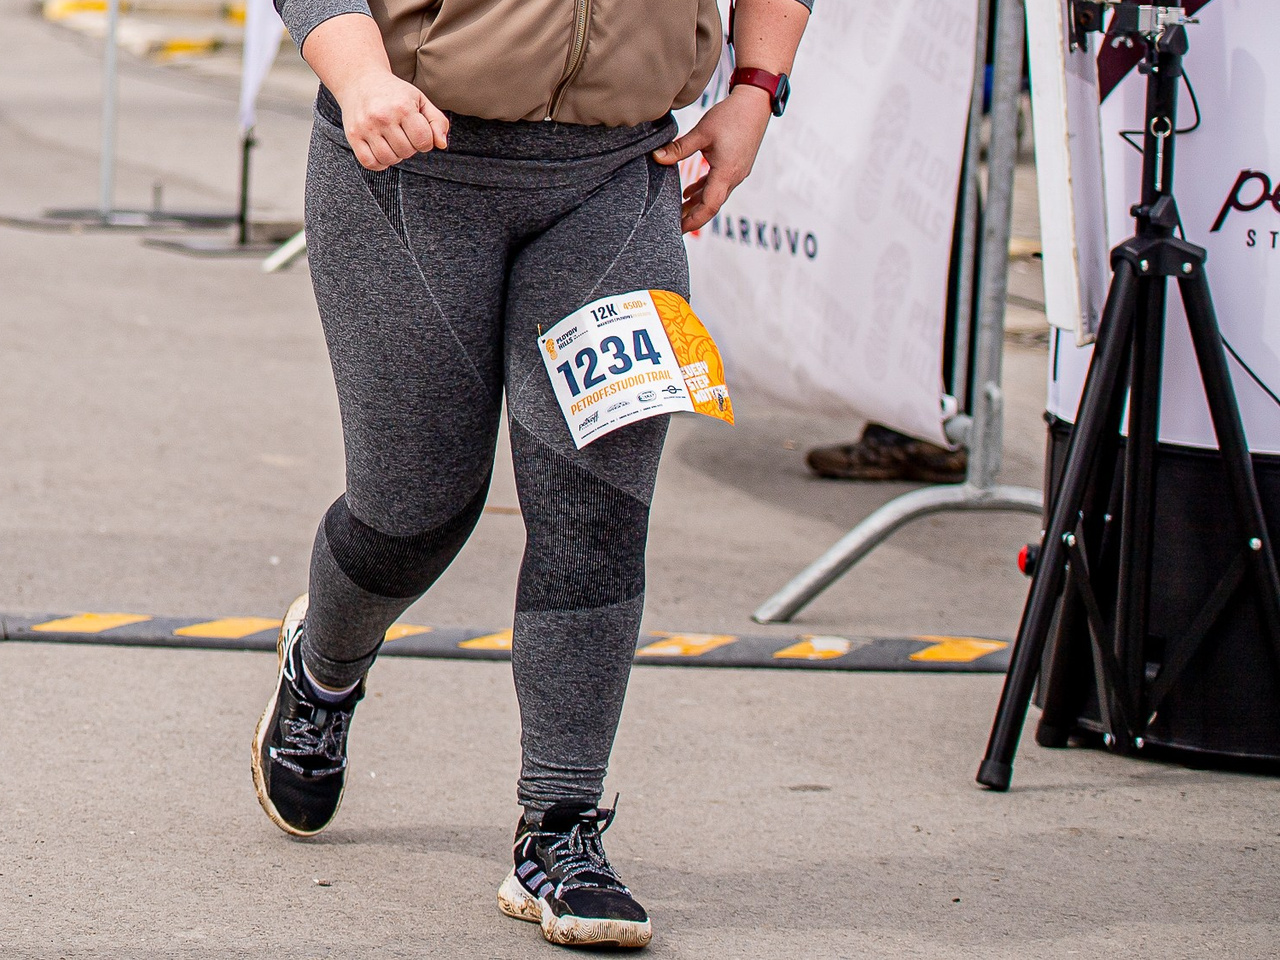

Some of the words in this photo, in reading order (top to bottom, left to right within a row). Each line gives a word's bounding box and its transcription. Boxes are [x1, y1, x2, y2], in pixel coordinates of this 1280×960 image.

[590, 303, 618, 322] 12K
[558, 336, 574, 351] HILLS
[556, 328, 662, 398] 1234
[646, 370, 673, 383] TRAIL
[684, 375, 710, 390] STEP
